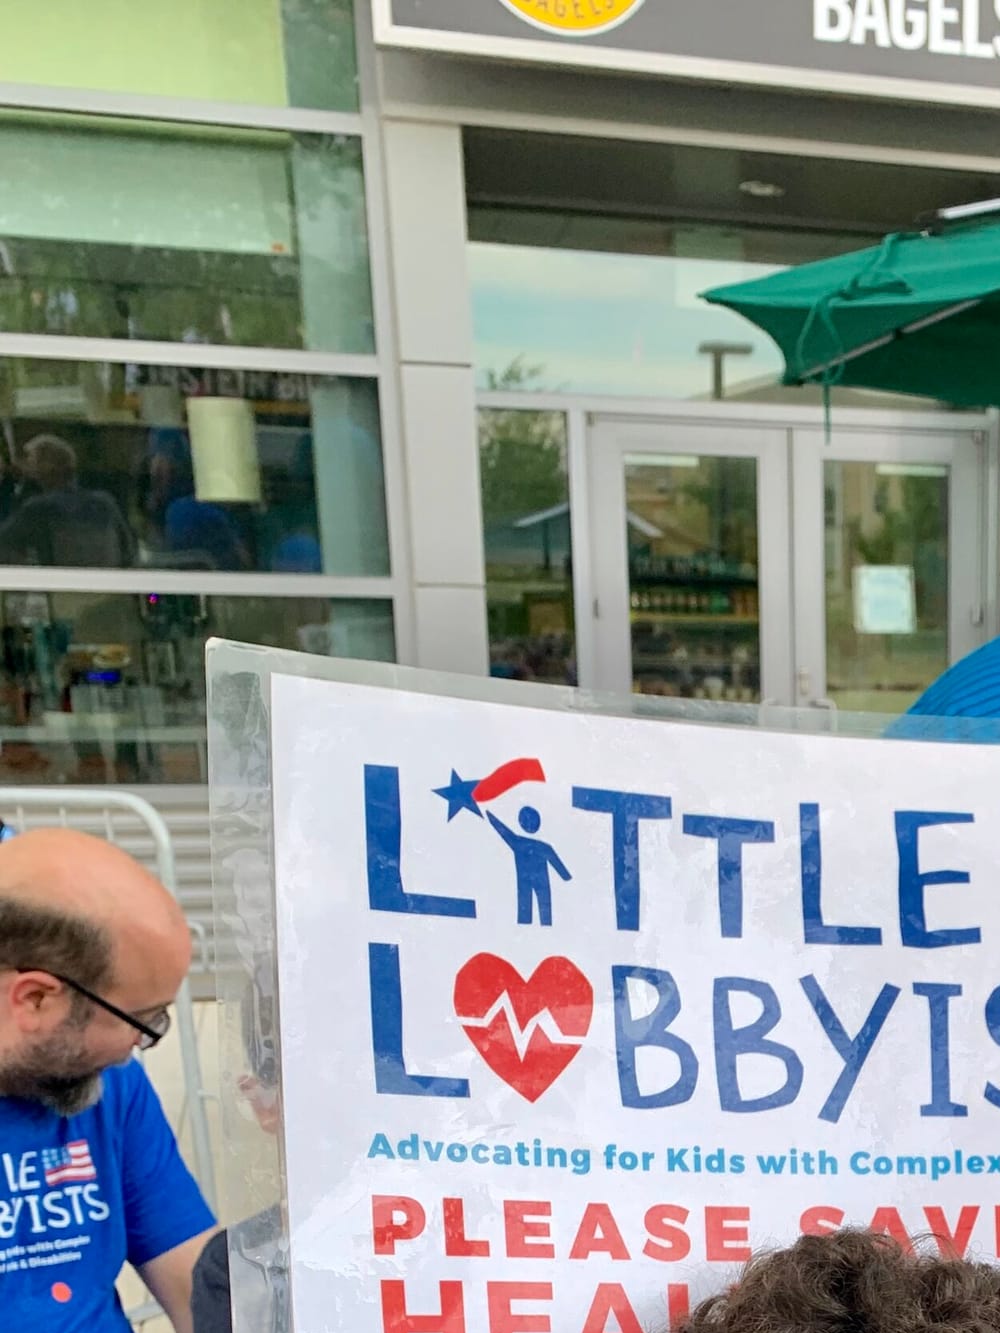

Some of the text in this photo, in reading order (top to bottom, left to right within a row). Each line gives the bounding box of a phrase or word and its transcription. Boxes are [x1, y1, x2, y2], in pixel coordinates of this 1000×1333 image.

[367, 1132, 591, 1176] Advocating
[603, 1143, 655, 1172] for
[667, 1145, 746, 1175] Kids
[757, 1149, 838, 1176] with
[371, 1193, 752, 1262] PLEASE
